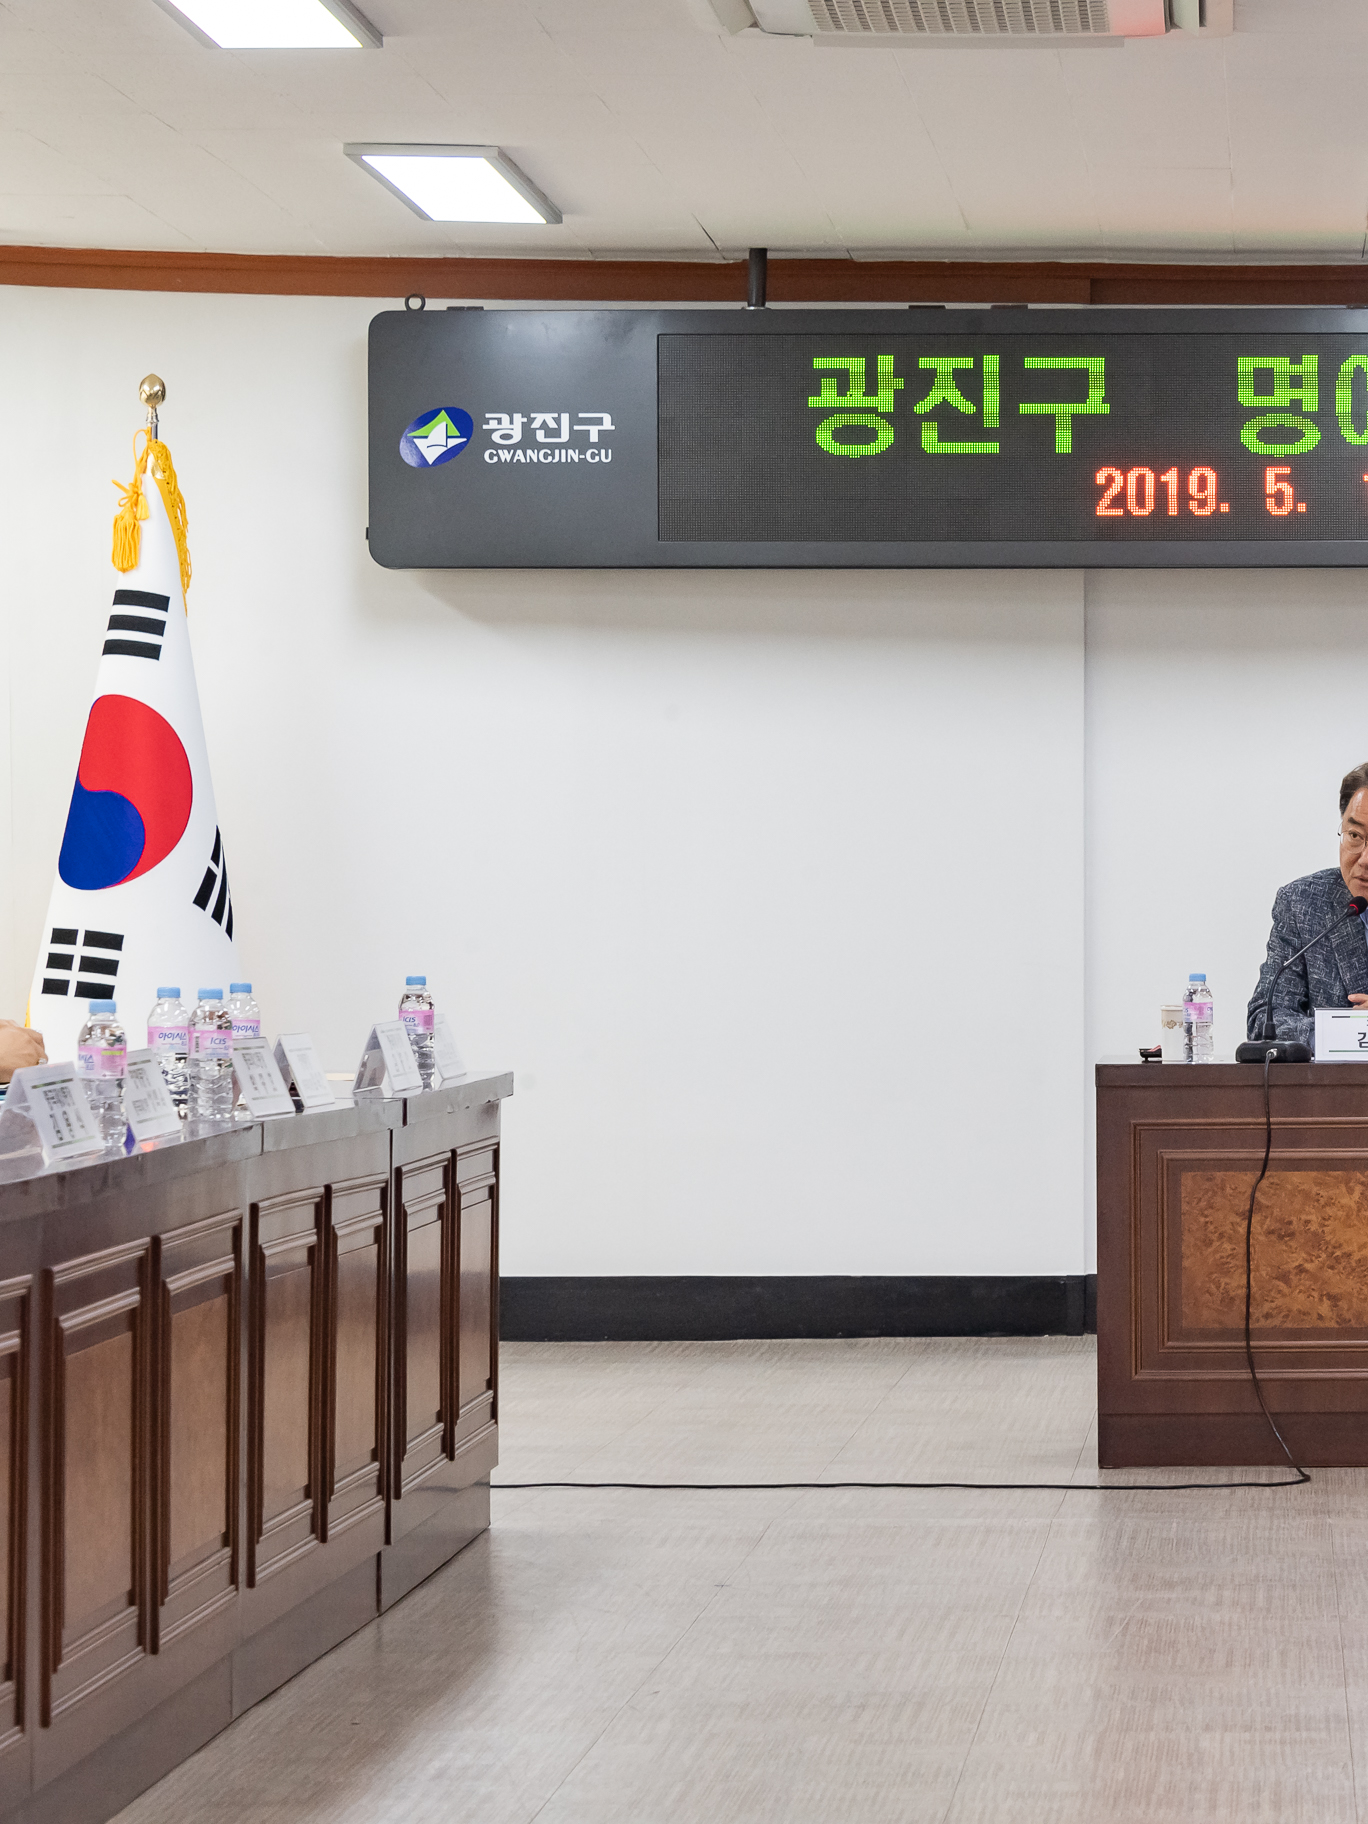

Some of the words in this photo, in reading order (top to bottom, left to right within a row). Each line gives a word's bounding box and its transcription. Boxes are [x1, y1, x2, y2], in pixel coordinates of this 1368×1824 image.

[808, 354, 1110, 459] 광진구
[482, 412, 616, 445] 광진구
[483, 448, 612, 464] GWANGJIN-GU
[1094, 465, 1231, 517] 2019.
[1264, 465, 1307, 517] 5.
